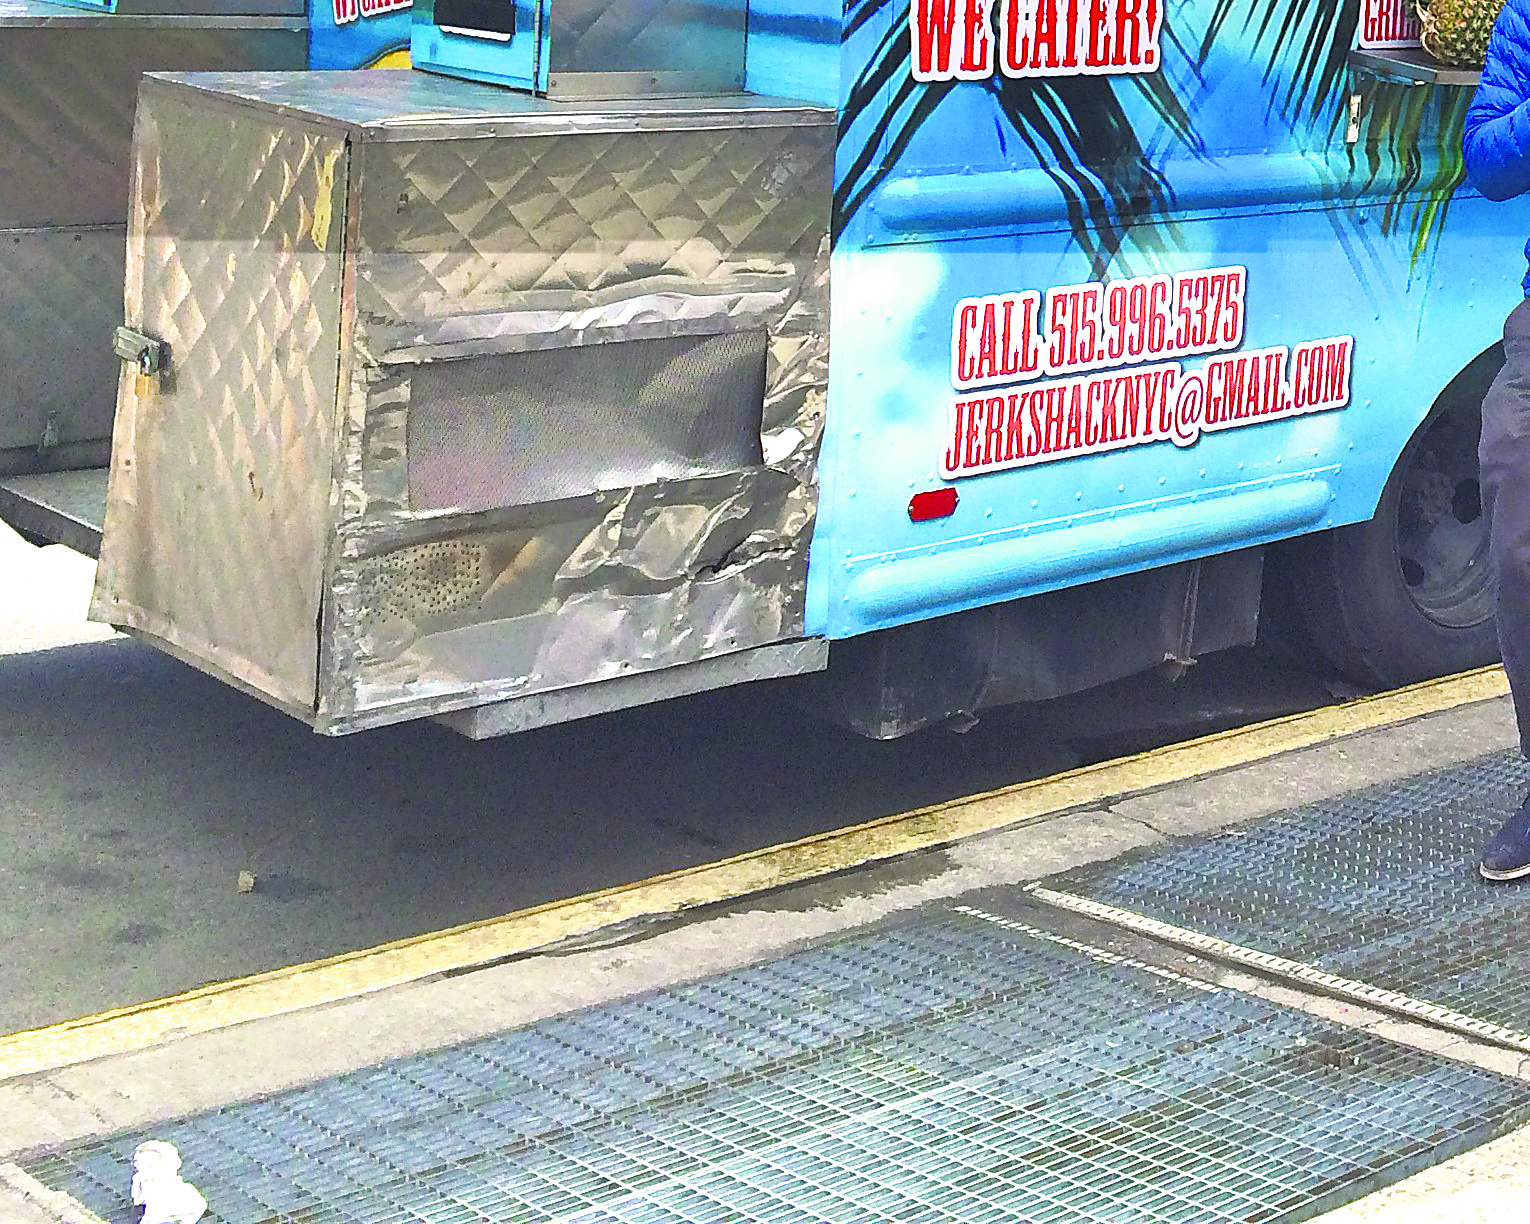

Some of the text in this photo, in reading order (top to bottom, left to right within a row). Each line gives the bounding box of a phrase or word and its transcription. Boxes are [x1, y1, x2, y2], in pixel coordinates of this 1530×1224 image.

[958, 273, 1241, 380] CALL 515.996.5375
[945, 342, 1348, 471] JERKSHACKNYC@GMAIL.COM
